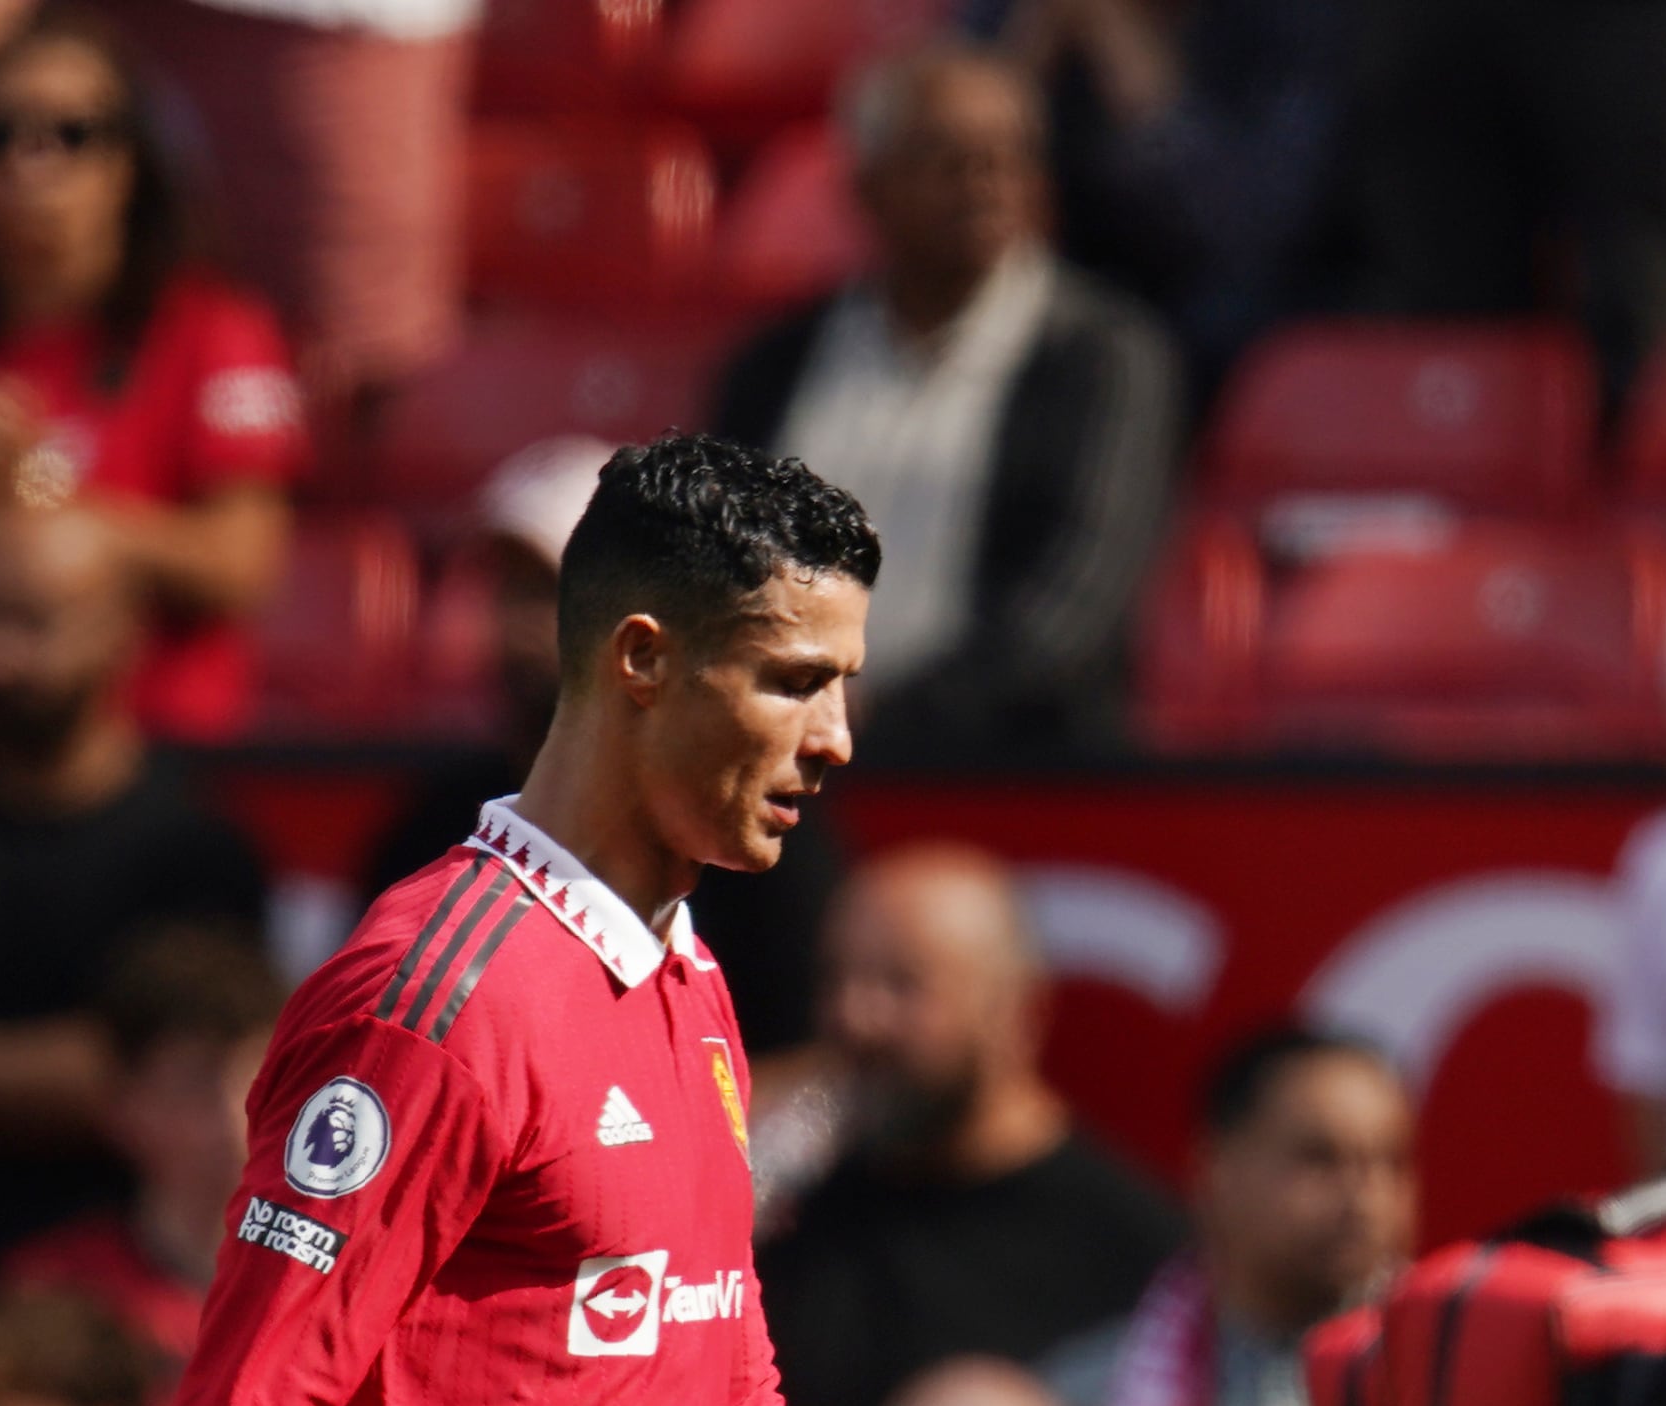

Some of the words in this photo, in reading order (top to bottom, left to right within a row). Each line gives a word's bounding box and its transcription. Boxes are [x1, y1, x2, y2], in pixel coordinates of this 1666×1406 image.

[237, 1218, 267, 1242] for
[263, 1229, 336, 1274] racism
[244, 1196, 274, 1223] No
[273, 1210, 336, 1251] room
